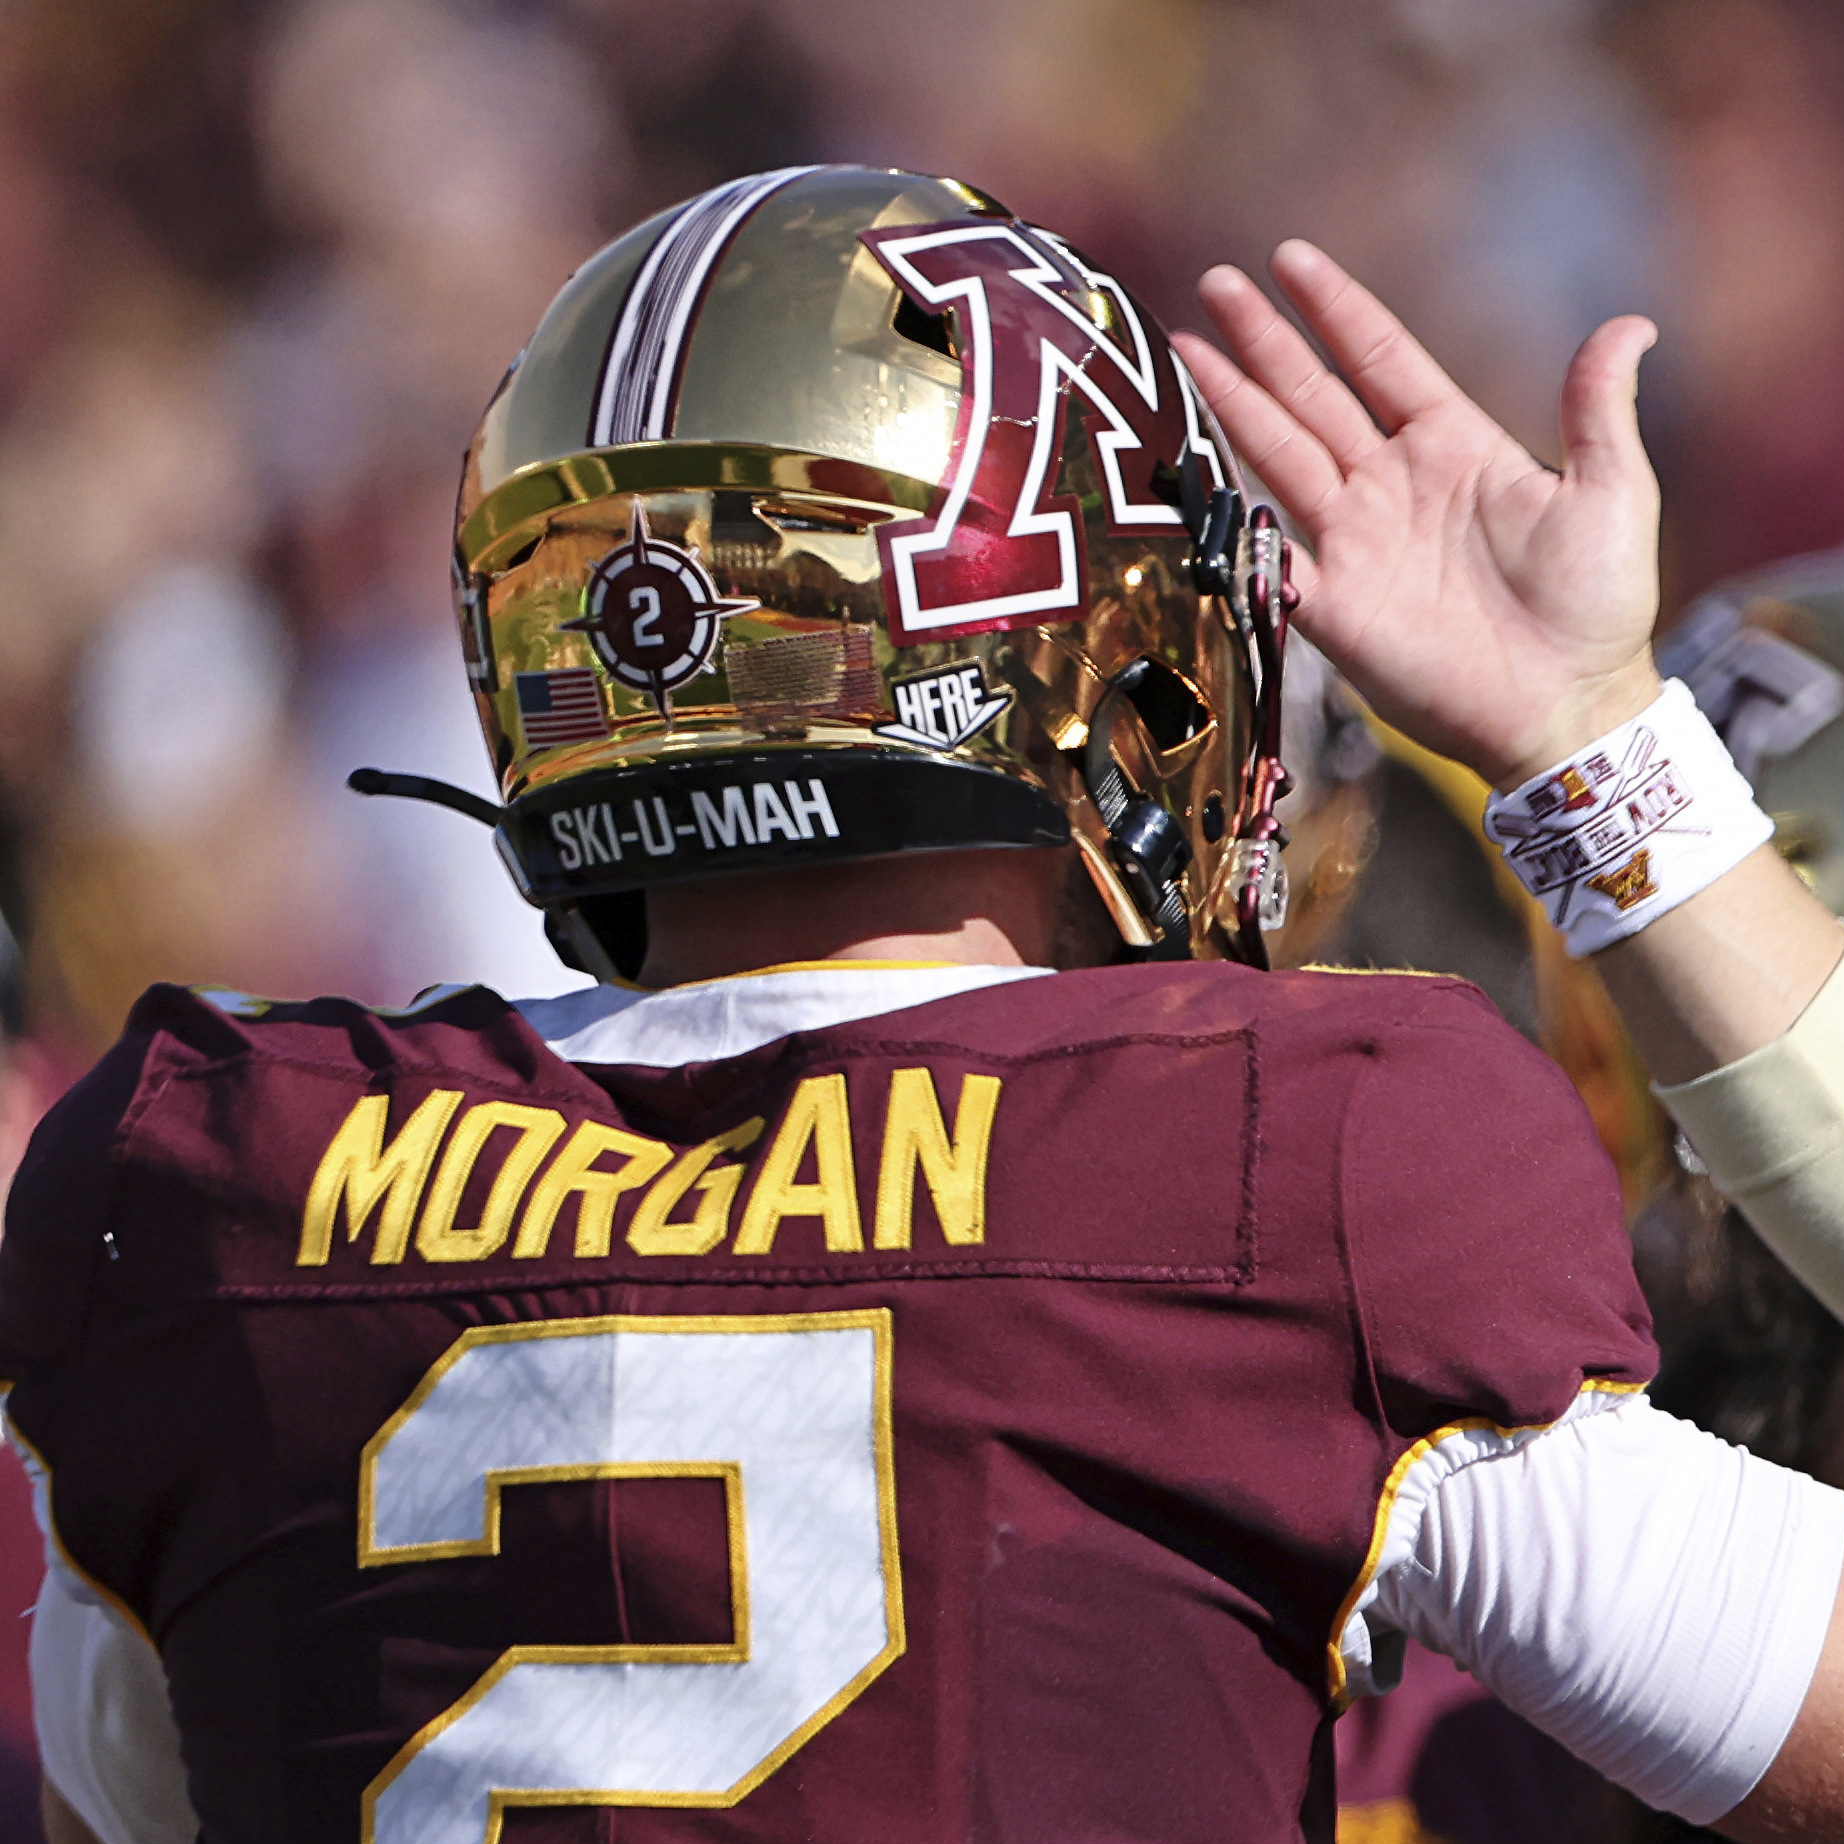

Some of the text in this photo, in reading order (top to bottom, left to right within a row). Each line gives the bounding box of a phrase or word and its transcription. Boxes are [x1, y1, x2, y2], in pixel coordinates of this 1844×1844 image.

[631, 585, 665, 648] 2
[894, 658, 988, 744] HERE
[549, 777, 841, 868] SKI-U-MAH
[296, 1068, 1001, 1268] MORGAN
